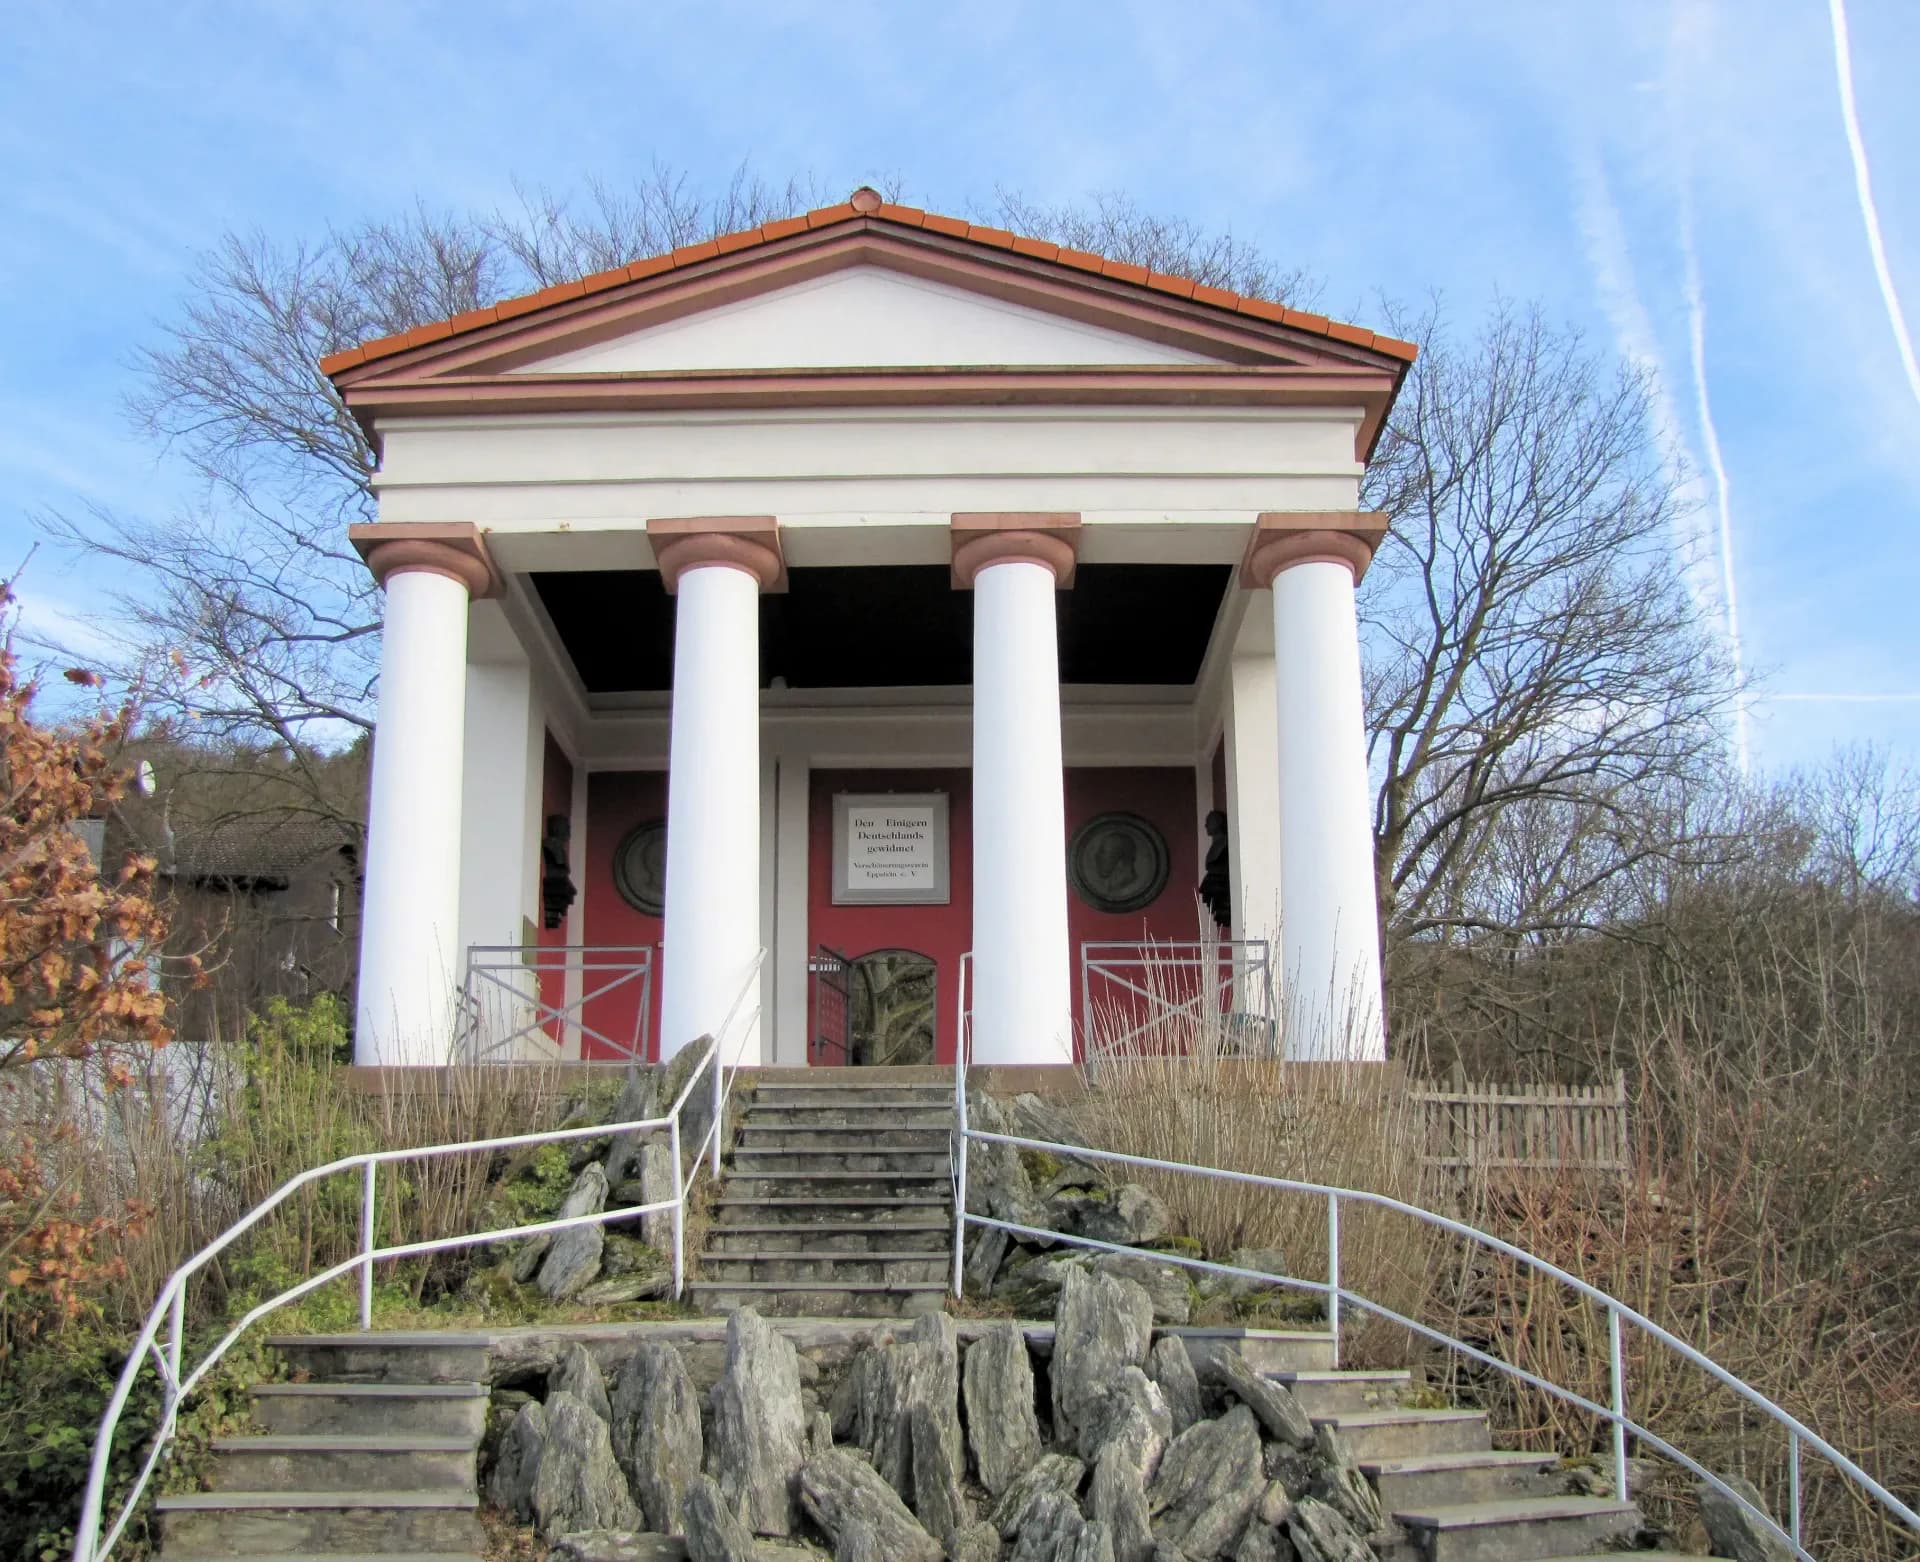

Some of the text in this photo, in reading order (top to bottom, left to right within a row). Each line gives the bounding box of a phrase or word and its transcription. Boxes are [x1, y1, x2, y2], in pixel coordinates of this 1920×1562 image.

[855, 819, 927, 828] Den Einigern
[858, 831, 924, 840] Deutschlands
[867, 844, 914, 854] gewidmet
